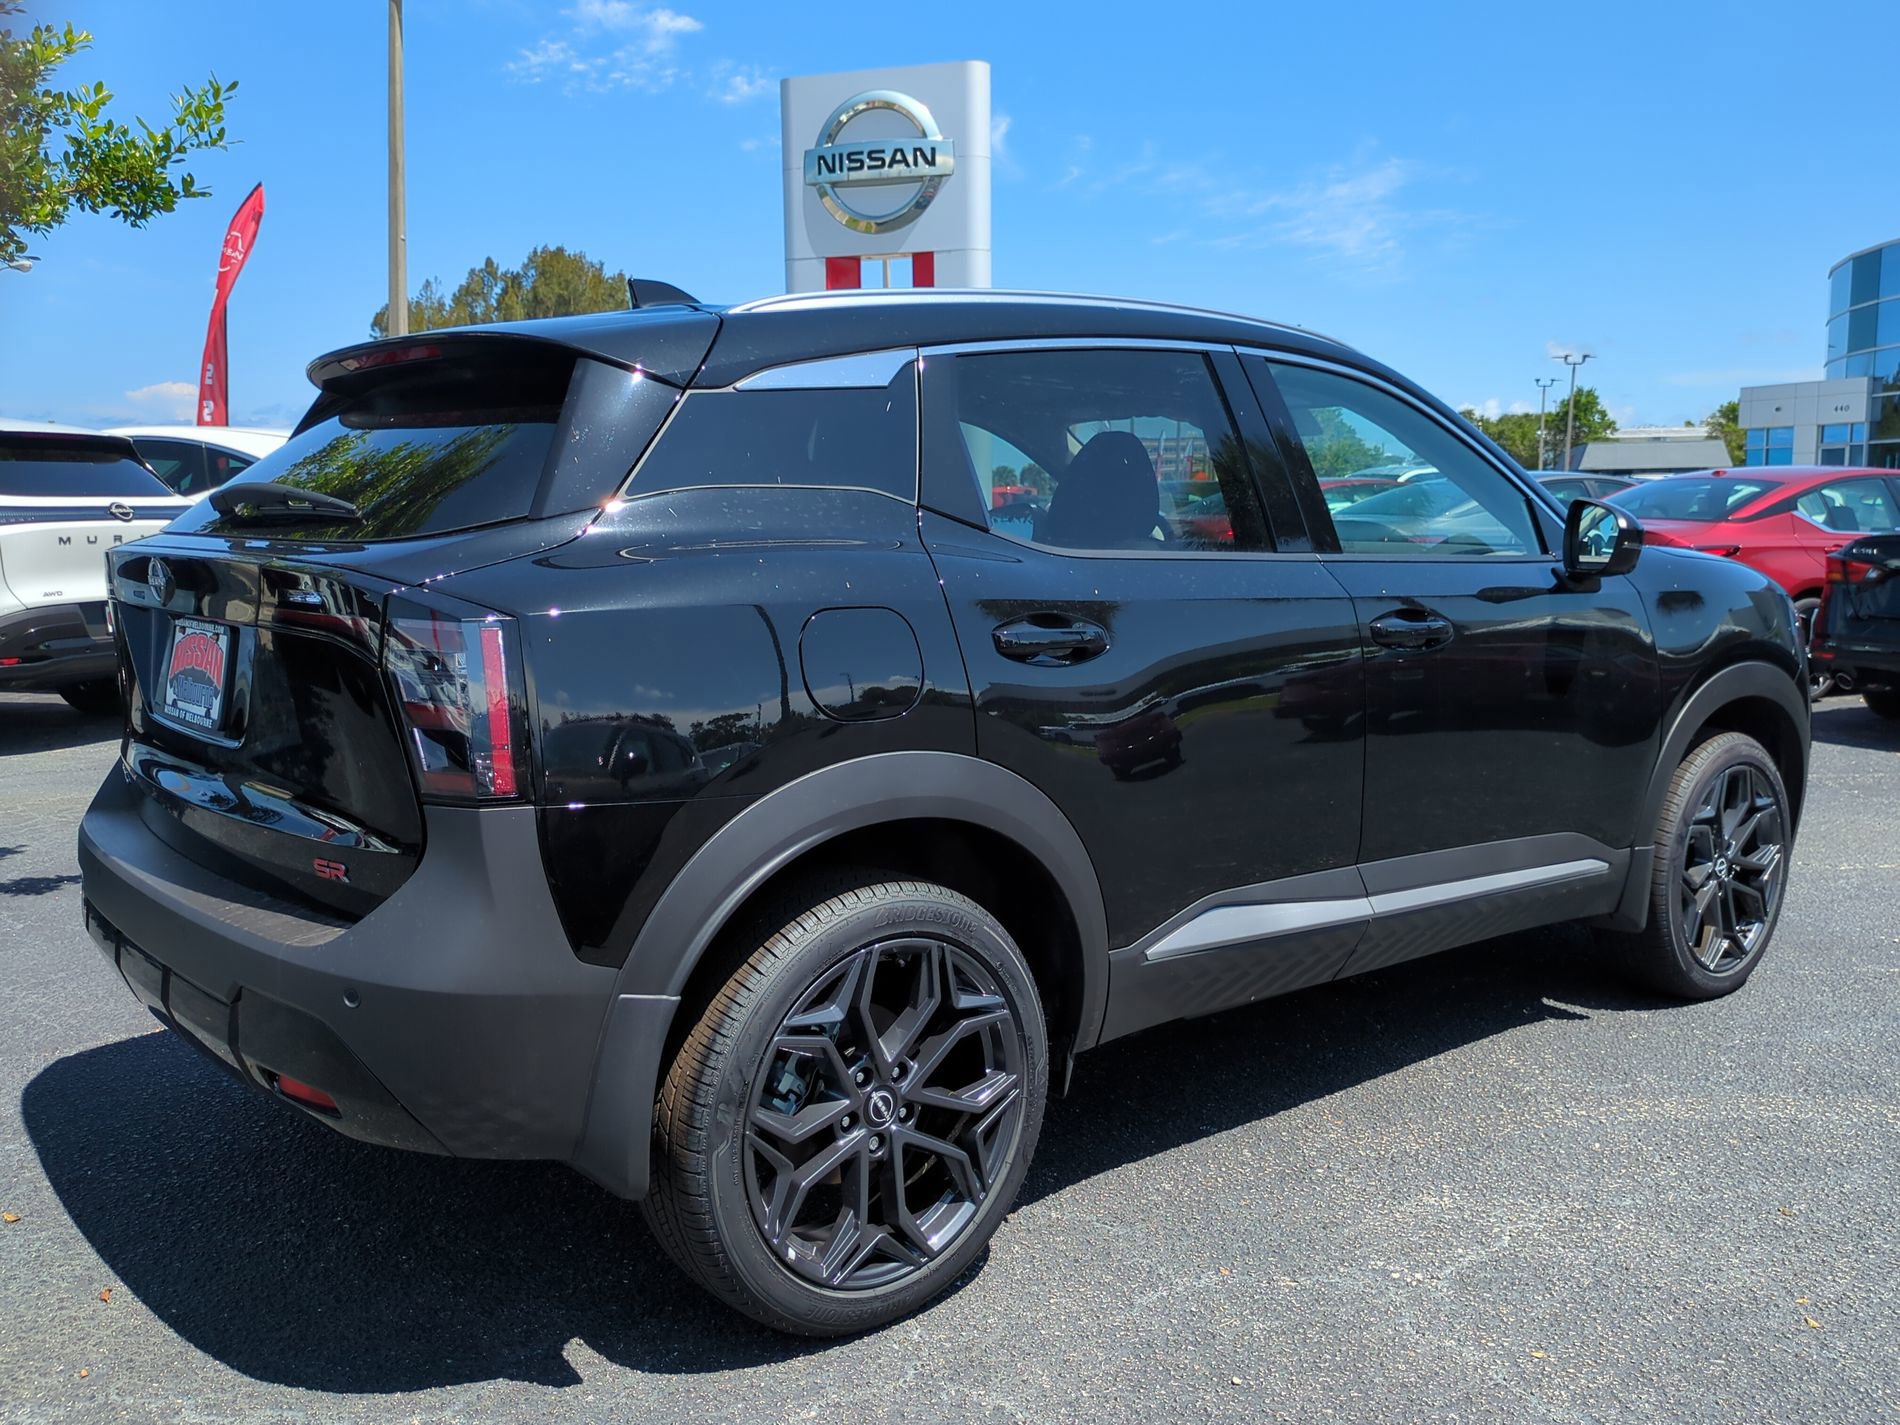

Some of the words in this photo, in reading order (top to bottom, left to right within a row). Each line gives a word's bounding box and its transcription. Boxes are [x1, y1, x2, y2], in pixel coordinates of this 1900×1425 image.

[817, 147, 936, 176] NISSAN
[1834, 404, 1850, 413] 440
[58, 534, 145, 546] MUR
[42, 590, 63, 598] AWD
[169, 632, 224, 689] NISSAN
[179, 709, 186, 720] OF
[186, 711, 213, 729] MELBOURNE
[313, 858, 350, 883] SR
